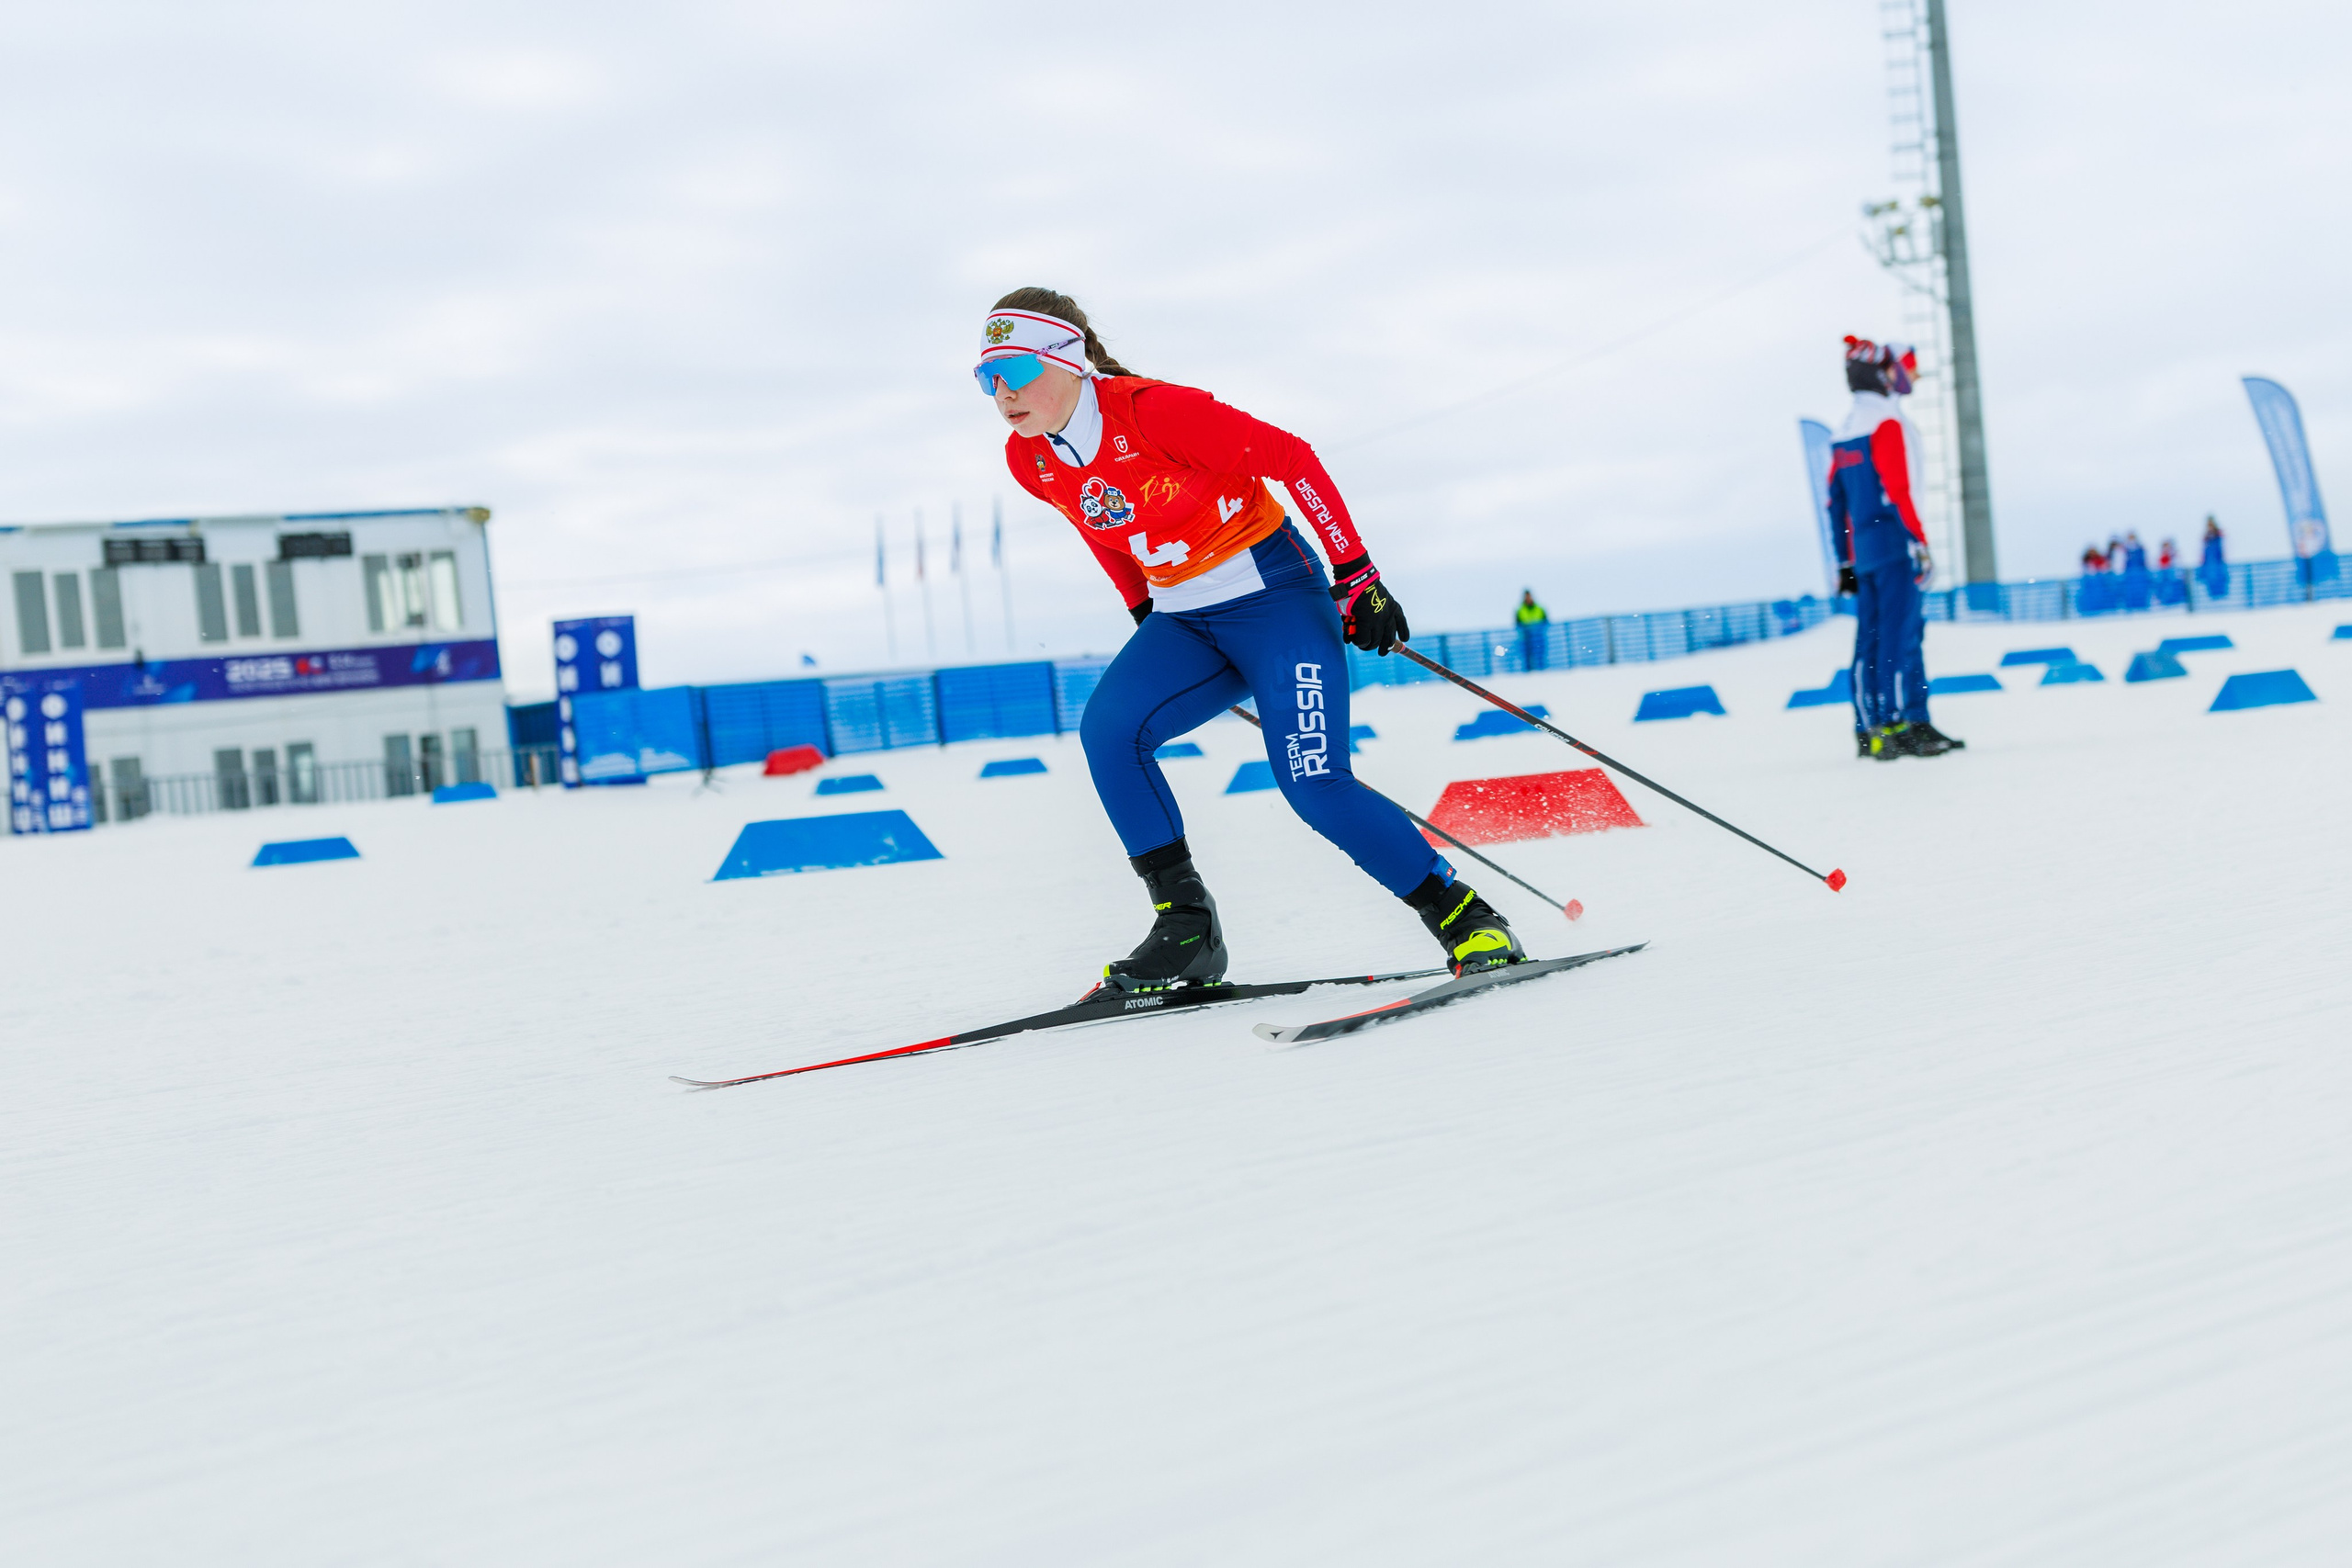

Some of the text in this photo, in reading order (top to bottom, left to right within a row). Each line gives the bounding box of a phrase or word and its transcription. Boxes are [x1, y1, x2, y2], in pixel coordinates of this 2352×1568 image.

[1217, 495, 1244, 525] 4
[1295, 477, 1350, 553] EAM RUSSIA
[1128, 531, 1192, 567] 4
[1295, 662, 1330, 777] RUSSIA
[1285, 733, 1305, 782] TEAM
[1440, 889, 1476, 930] FISCHER
[1125, 996, 1164, 1010] ATOMIC
